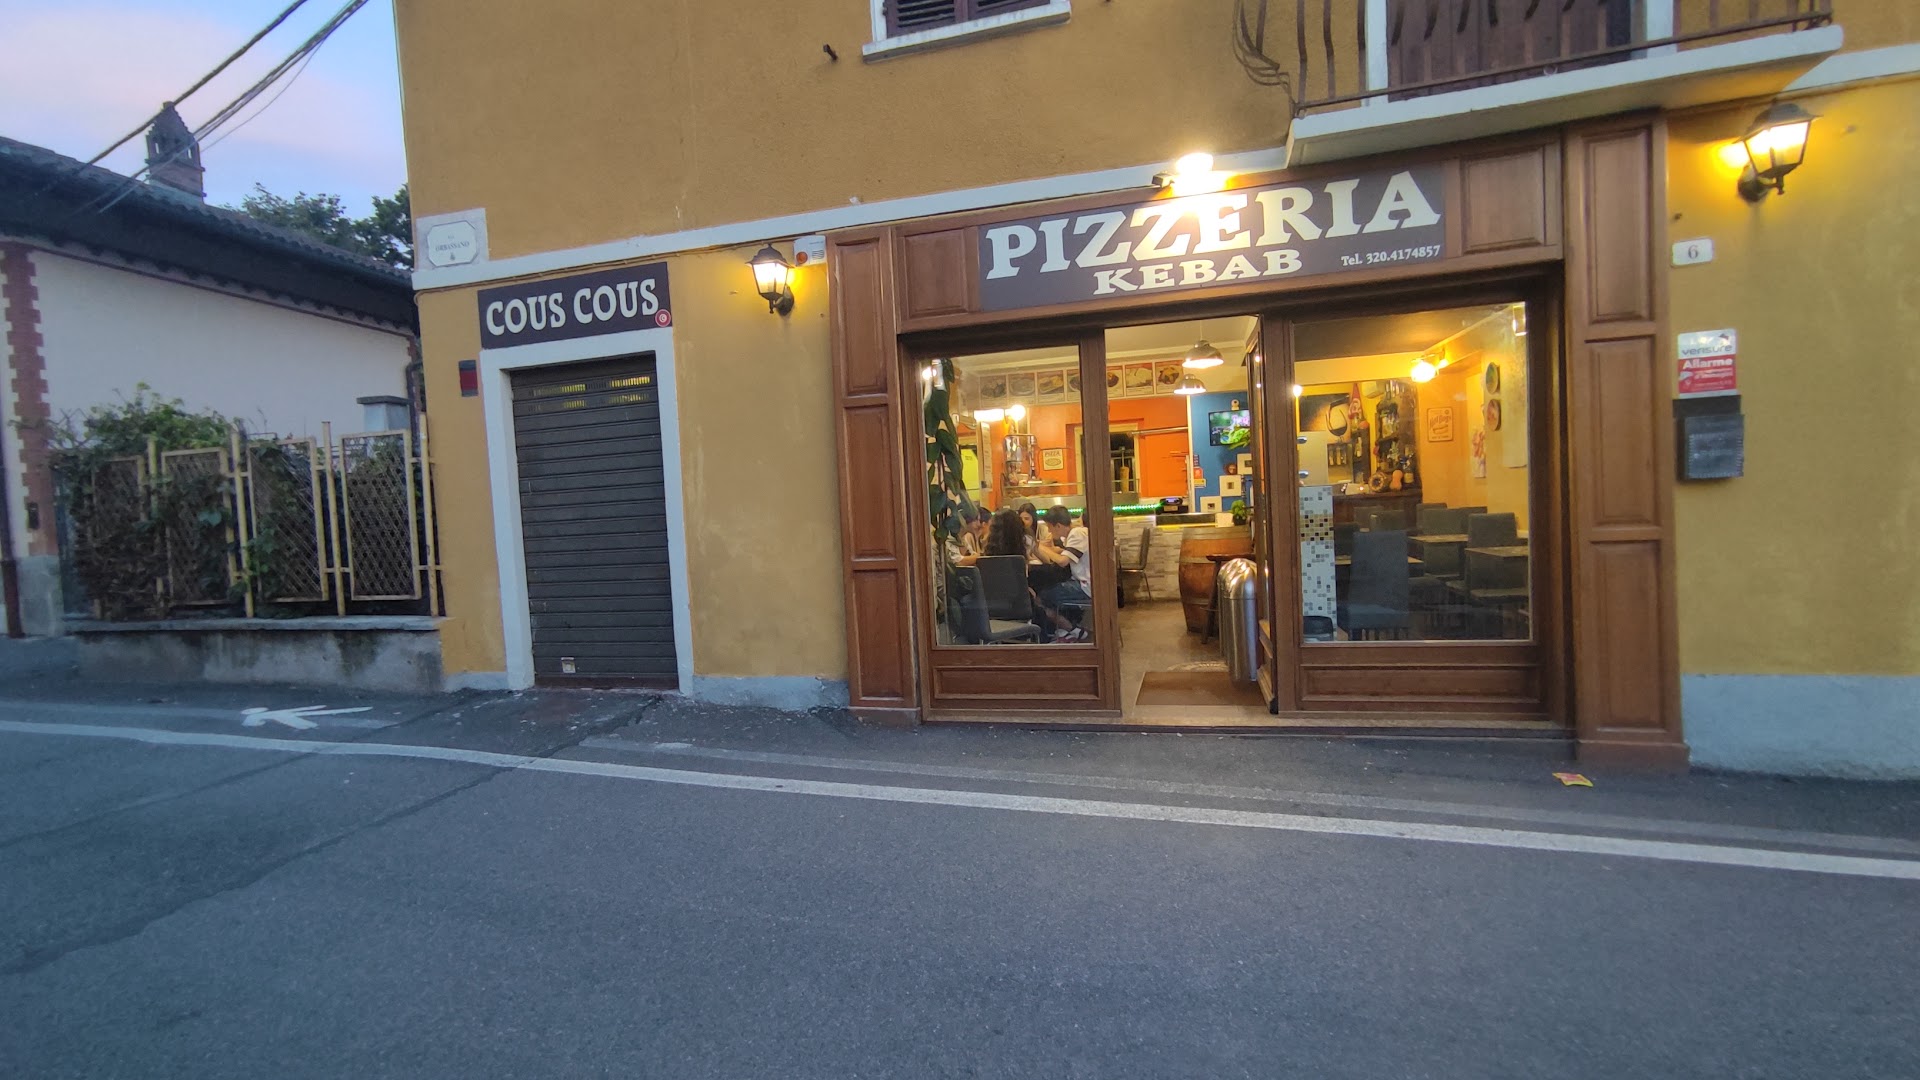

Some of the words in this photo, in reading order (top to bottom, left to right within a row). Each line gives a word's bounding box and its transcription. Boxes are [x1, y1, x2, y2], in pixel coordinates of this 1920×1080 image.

[985, 171, 1441, 280] PIZZERIA
[1341, 253, 1362, 266] Tel.
[1366, 245, 1440, 264] 320.4174857
[1688, 244, 1698, 259] 6
[1093, 249, 1302, 295] KEBAB
[486, 292, 566, 336] COUS
[573, 278, 659, 324] COUS
[1682, 345, 1732, 355] verisure
[1682, 358, 1733, 370] Allarme
